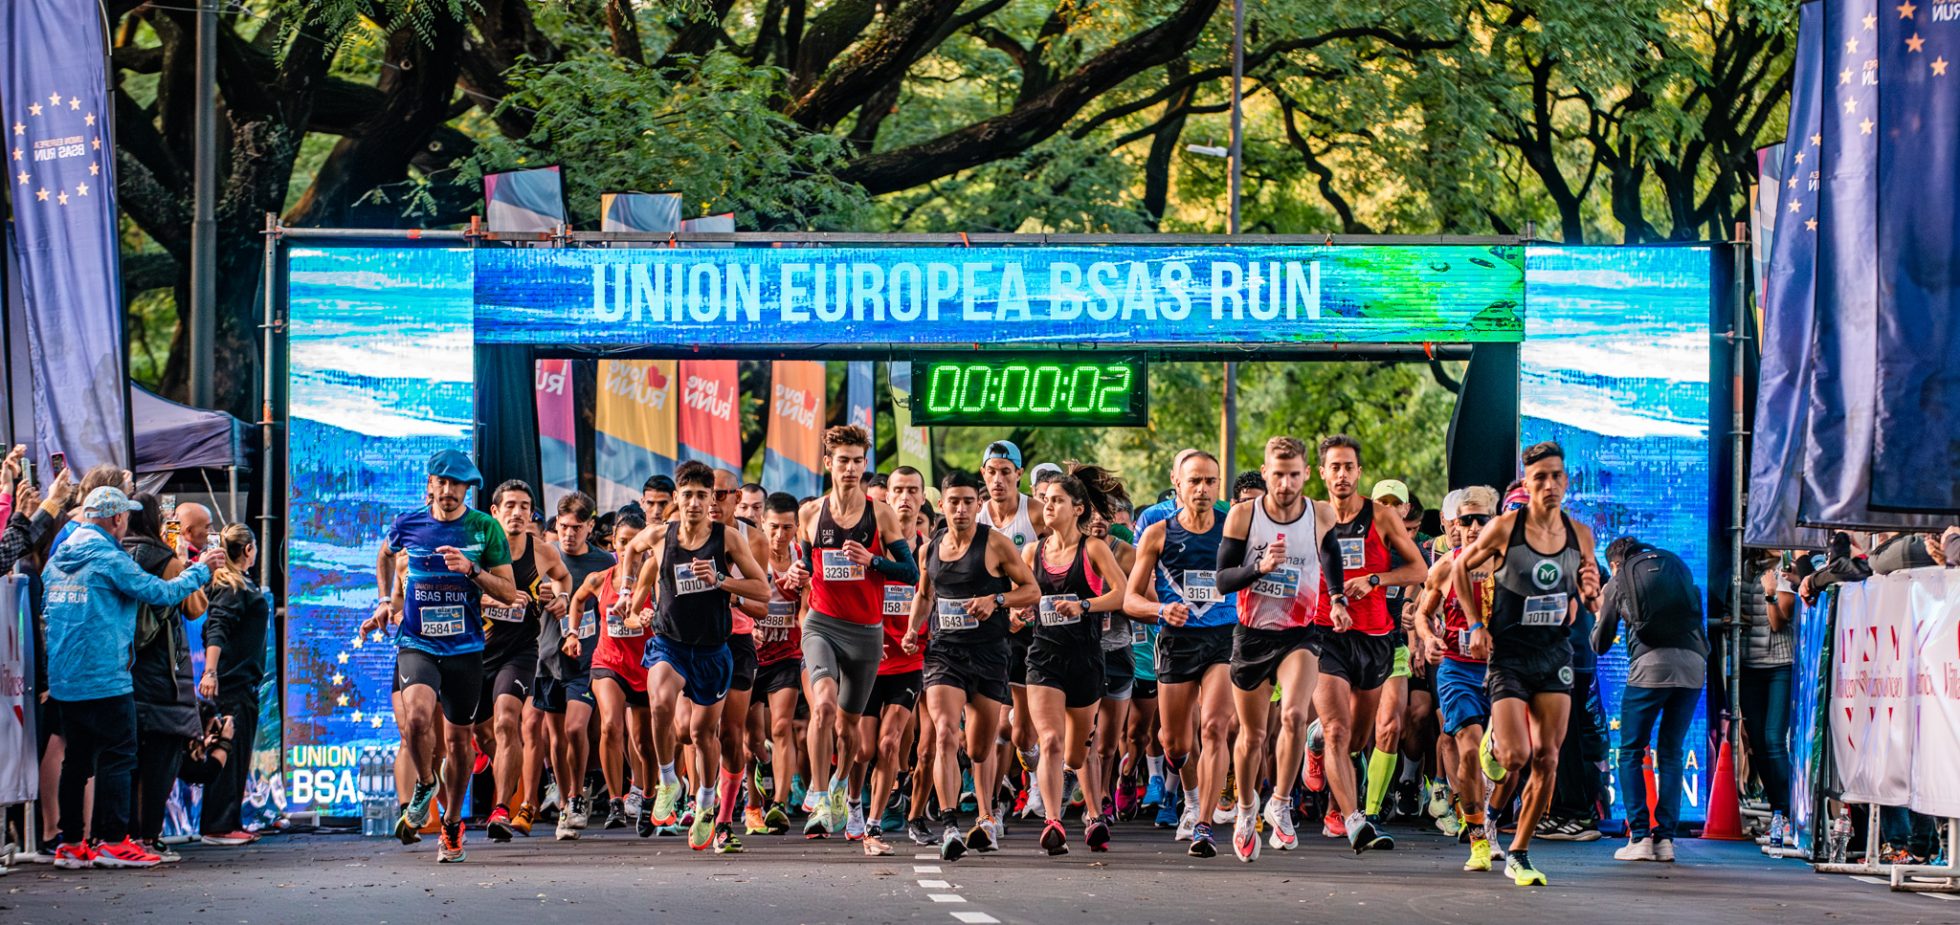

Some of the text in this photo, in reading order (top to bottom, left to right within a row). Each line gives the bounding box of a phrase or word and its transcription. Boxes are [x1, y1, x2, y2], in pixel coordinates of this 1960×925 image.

[593, 260, 1321, 322] UNION EUROPEA BSAS RUN
[929, 365, 1132, 412] 00:00:02
[825, 567, 850, 579] 3236
[680, 580, 702, 592] 1010
[1254, 580, 1283, 596] 2345
[68, 592, 88, 604] RUN
[415, 590, 468, 603] BSAS RUN
[1188, 587, 1211, 599] 3151
[941, 615, 962, 627] 1643
[1528, 612, 1551, 624] 1011
[424, 623, 450, 635] 2584
[293, 745, 358, 768] UNION
[292, 769, 366, 804] BSA
